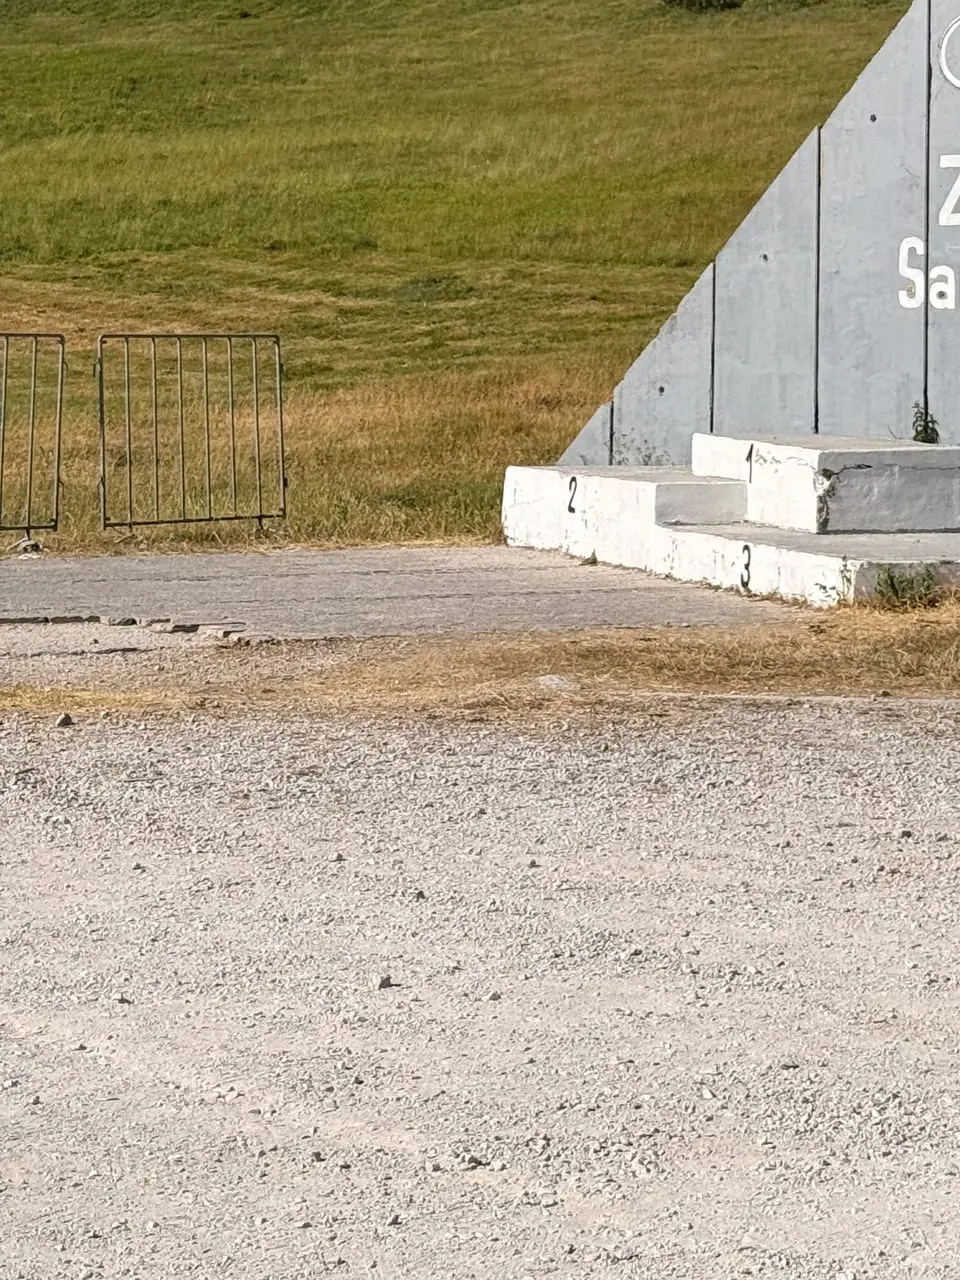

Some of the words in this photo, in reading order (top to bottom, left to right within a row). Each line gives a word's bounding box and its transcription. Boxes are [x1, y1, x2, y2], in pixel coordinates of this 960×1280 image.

[746, 444, 755, 483] 1
[568, 476, 578, 514] 2
[740, 544, 751, 589] 3
